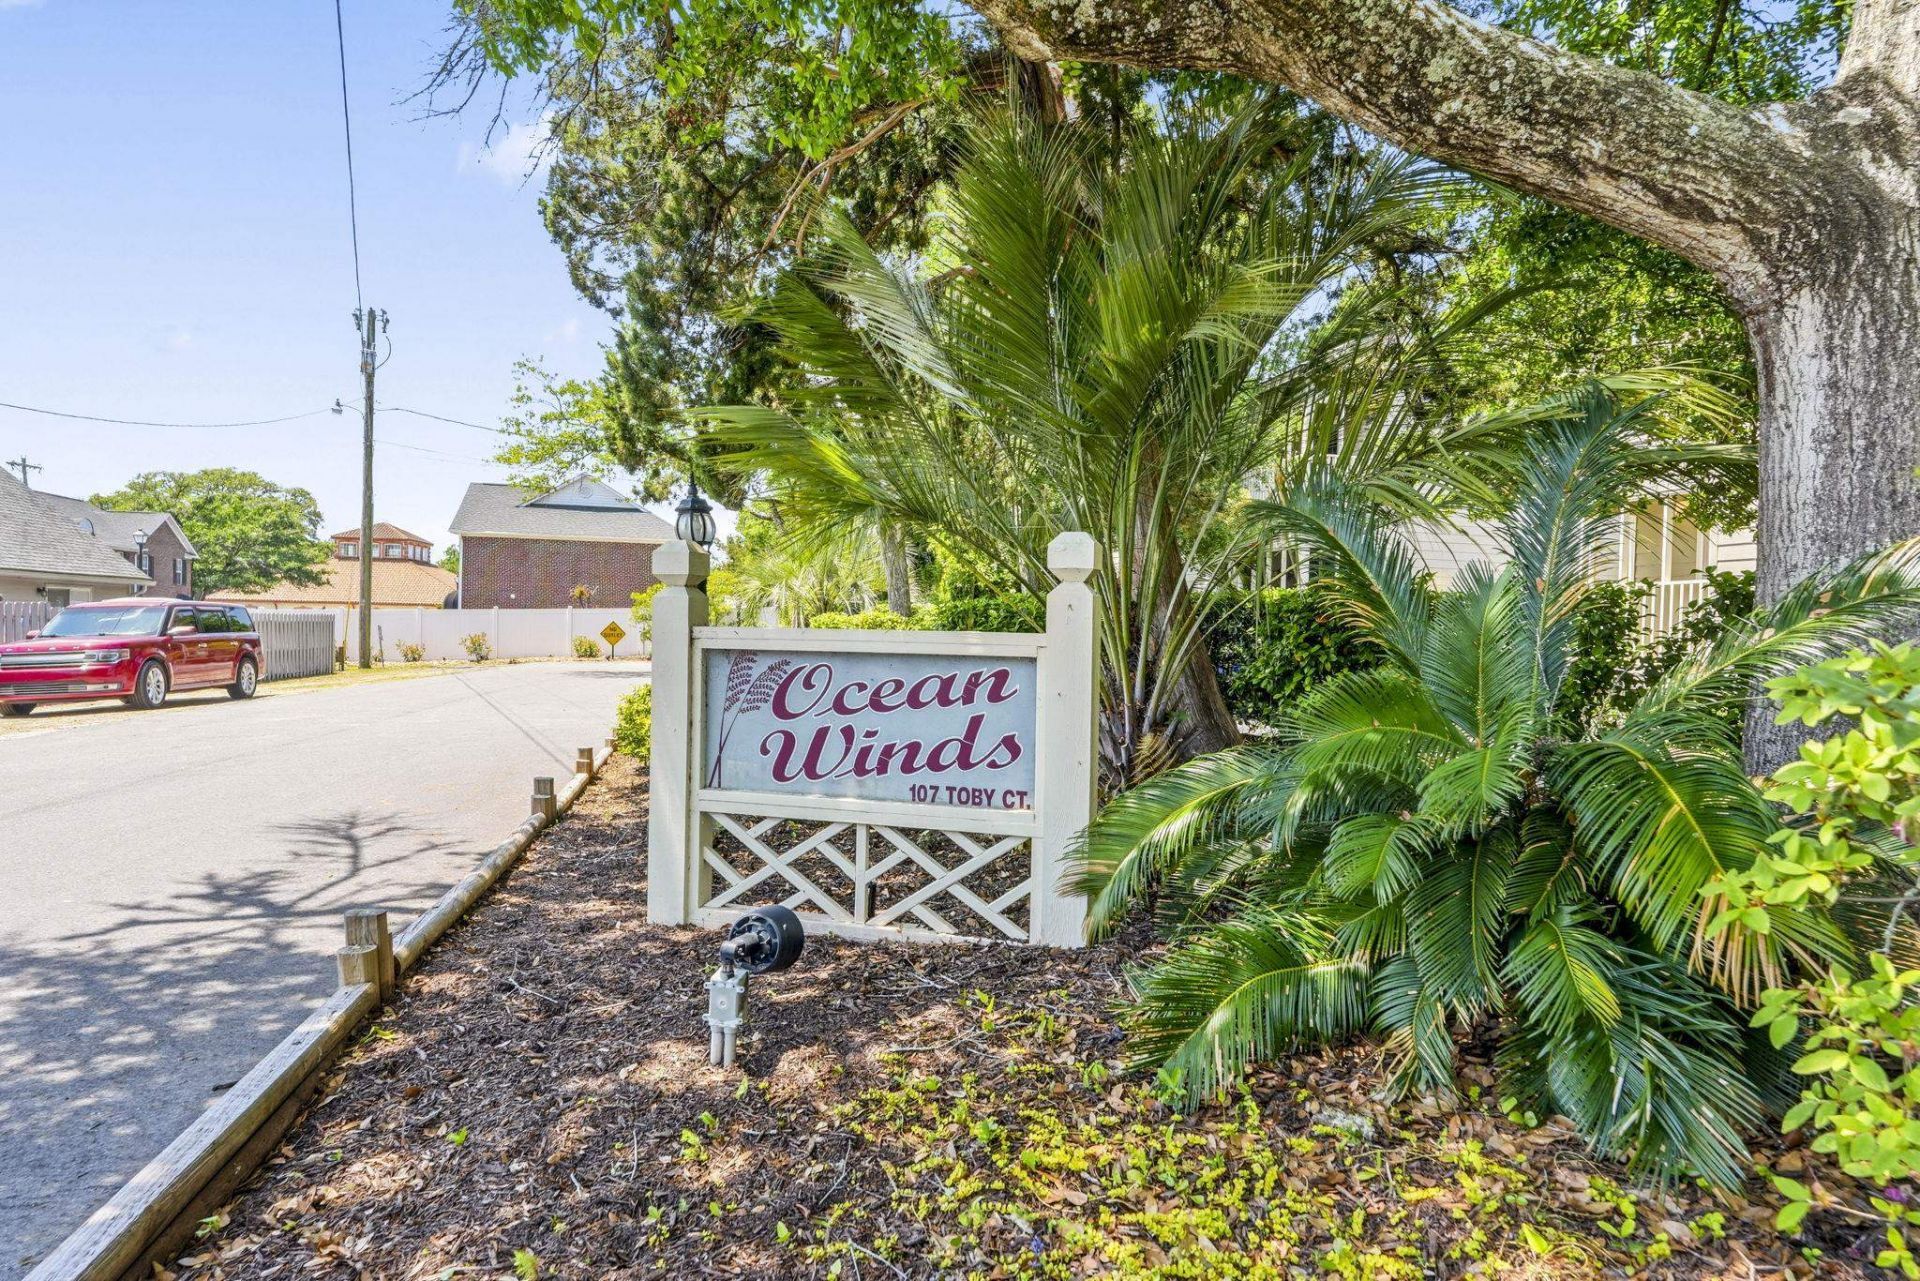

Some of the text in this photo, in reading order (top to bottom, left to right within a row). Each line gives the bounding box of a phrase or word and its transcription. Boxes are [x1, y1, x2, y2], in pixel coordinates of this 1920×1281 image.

[771, 663, 1019, 721] Ocean
[760, 713, 1023, 783] Winds
[909, 784, 1031, 810] 107 TOBY CT.
